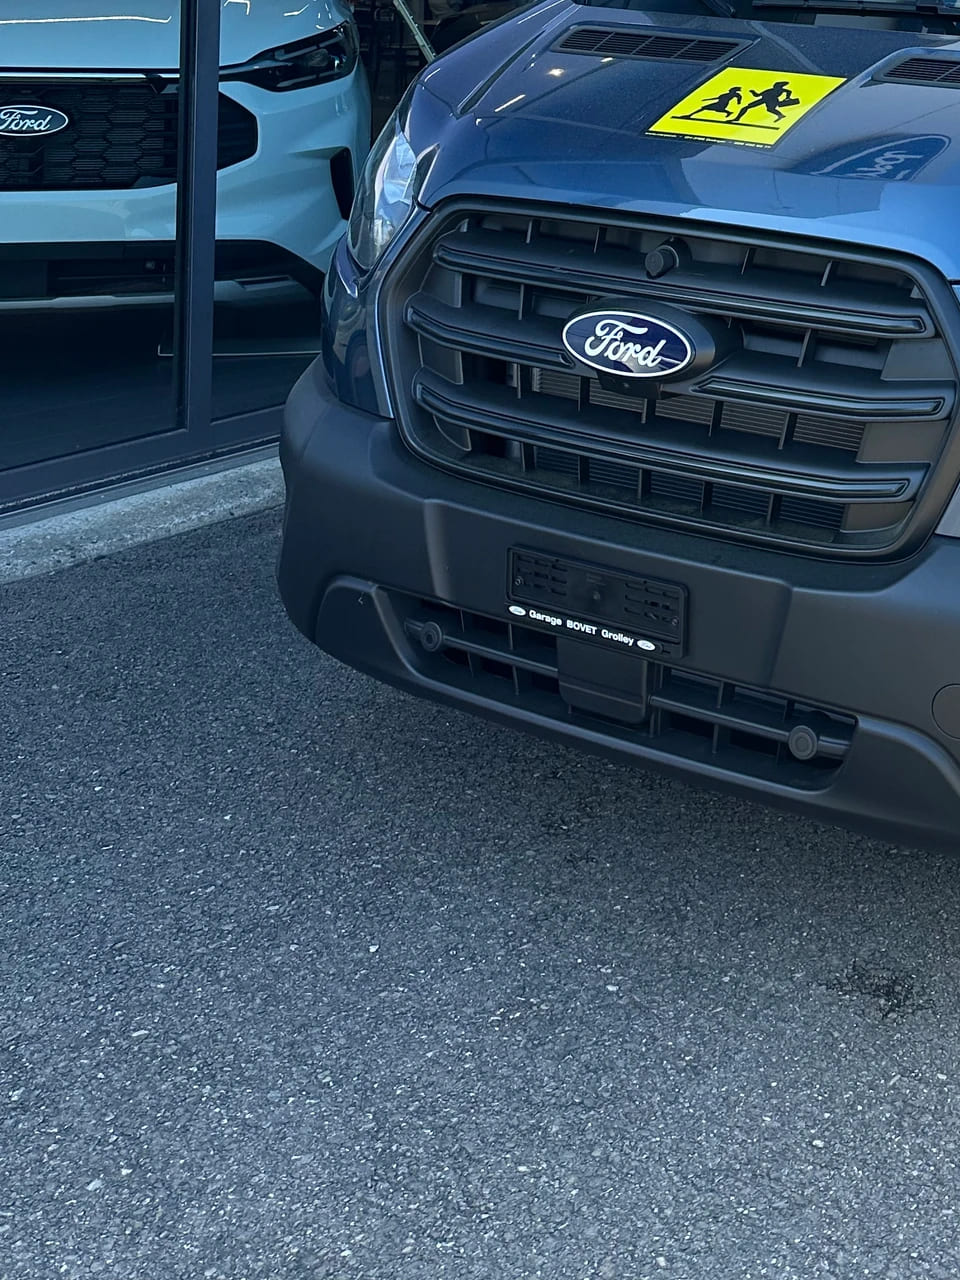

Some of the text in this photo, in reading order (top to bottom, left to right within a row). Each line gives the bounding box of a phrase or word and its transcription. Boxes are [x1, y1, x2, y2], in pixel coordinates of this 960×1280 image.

[0, 109, 52, 131] Ford
[584, 319, 667, 368] Ford
[529, 609, 563, 626] Garage
[566, 619, 598, 635] BOVET
[601, 629, 635, 647] Grolley
